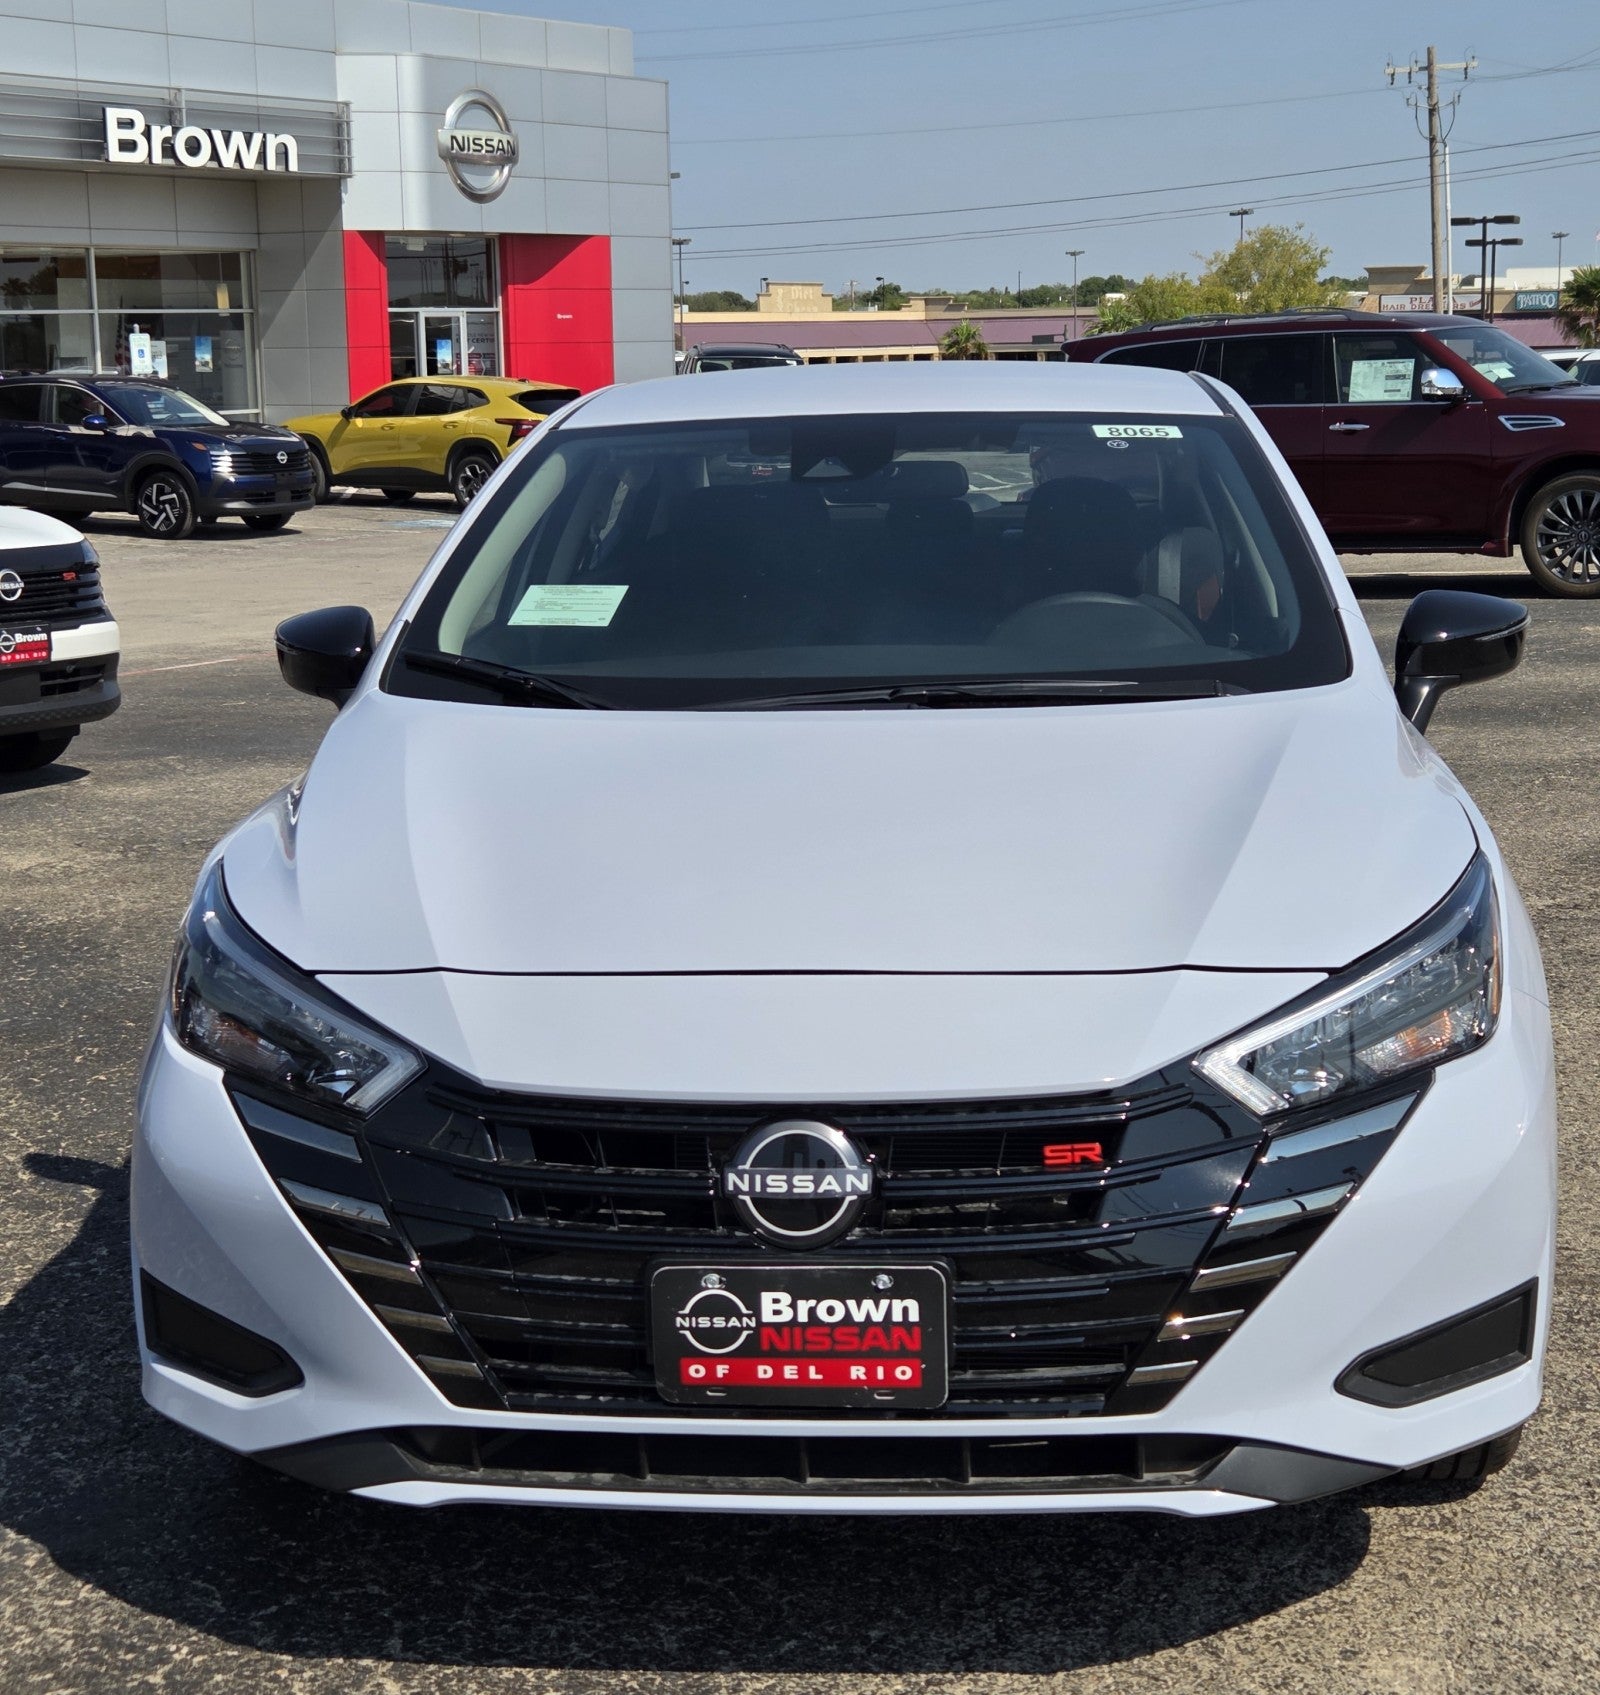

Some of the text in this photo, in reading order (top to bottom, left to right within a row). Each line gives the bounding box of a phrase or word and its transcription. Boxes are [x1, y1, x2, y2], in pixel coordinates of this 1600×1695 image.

[104, 107, 299, 172] Brown
[450, 134, 516, 156] NISSAN
[1107, 427, 1170, 437] 8065
[15, 633, 48, 643] Brown
[1043, 1142, 1103, 1165] SR
[727, 1172, 869, 1194] NISSAN
[760, 1291, 920, 1323] Brown
[675, 1316, 757, 1328] NISSAN
[760, 1326, 922, 1351] NISSAN
[688, 1364, 914, 1381] OF DEL RIO
